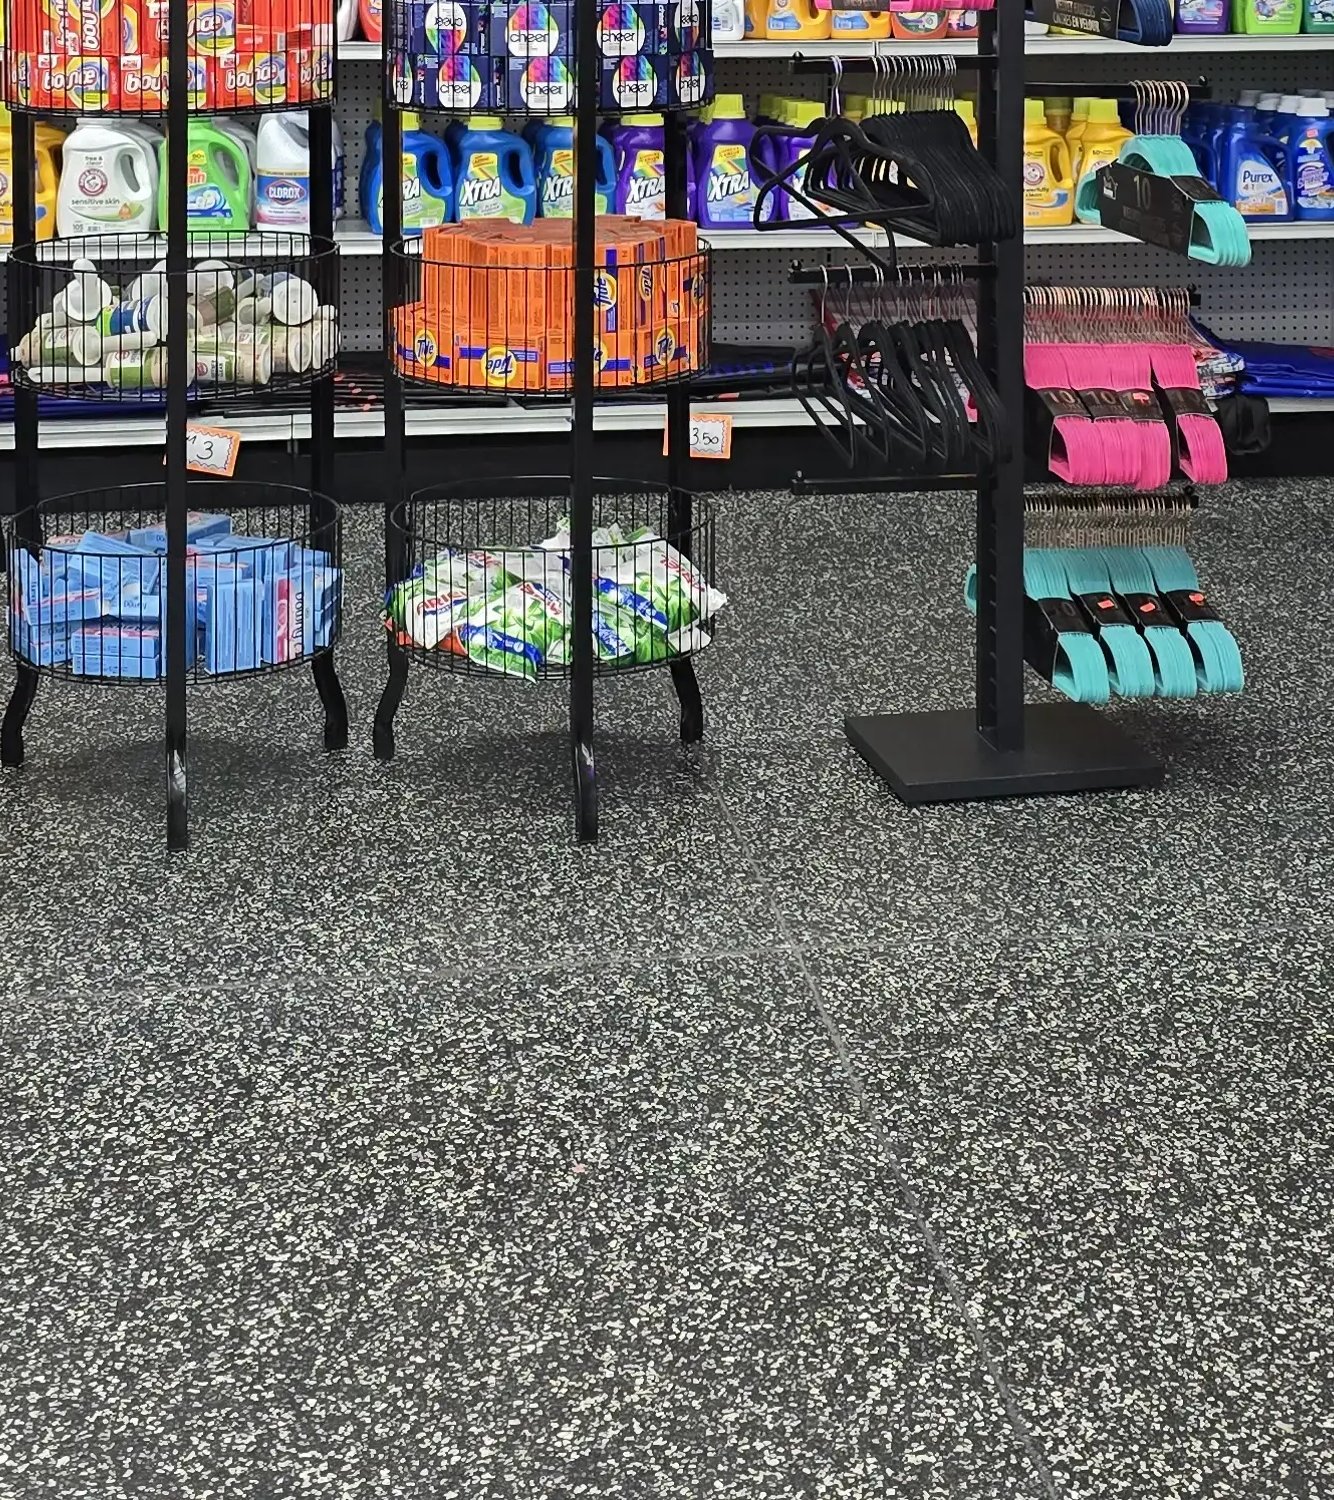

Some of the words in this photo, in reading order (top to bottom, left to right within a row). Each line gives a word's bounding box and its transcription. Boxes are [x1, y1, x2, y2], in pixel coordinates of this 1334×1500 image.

[509, 31, 551, 44] cheer
[601, 30, 635, 44] cheer
[43, 68, 97, 93] bounce
[226, 63, 277, 89] bounce
[440, 82, 472, 96] cheer
[525, 83, 564, 97] cheer
[617, 82, 649, 96] cheer
[1243, 171, 1273, 184] Purex
[266, 186, 301, 199] CLOROX
[461, 176, 501, 204] XTRA
[709, 171, 749, 201] XTRA
[71, 197, 103, 205] sensitive
[105, 197, 120, 205] skin
[691, 427, 719, 446] 3.50
[197, 440, 213, 460] 3
